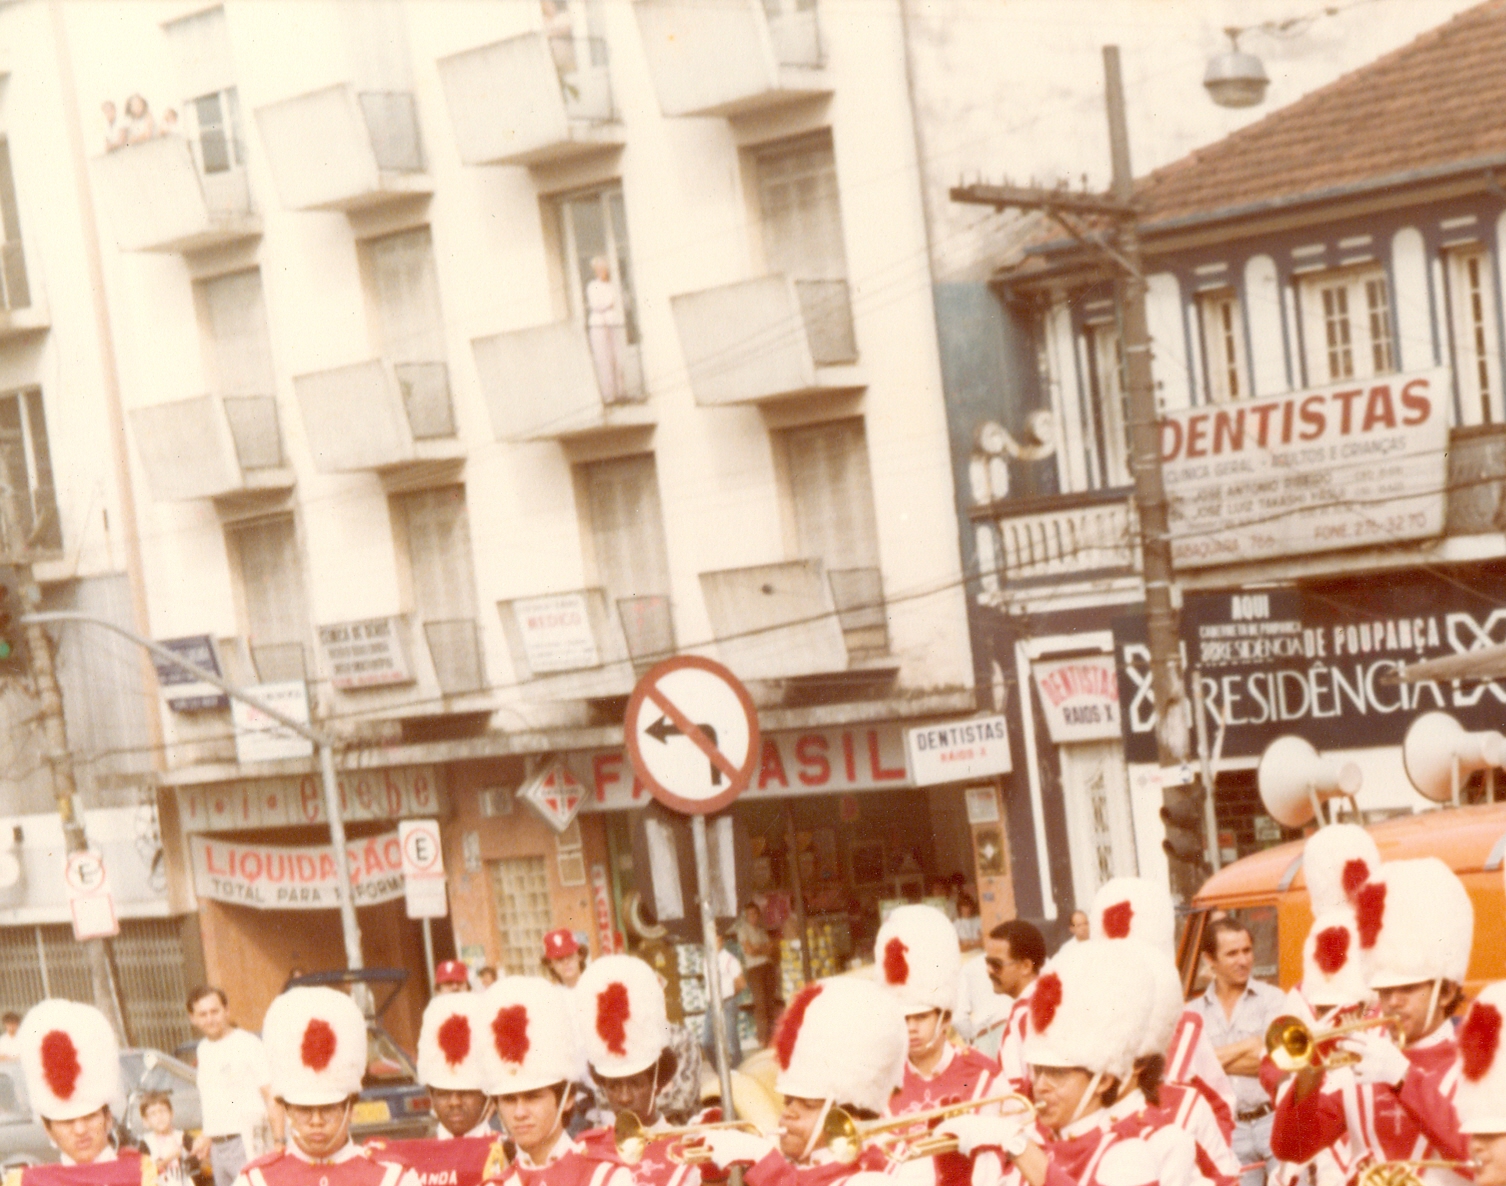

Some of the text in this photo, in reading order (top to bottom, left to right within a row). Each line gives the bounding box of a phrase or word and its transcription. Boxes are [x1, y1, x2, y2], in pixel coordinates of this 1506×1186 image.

[1158, 378, 1431, 463] DENTISTAS
[1333, 617, 1440, 656] POUPANÇA
[1199, 654, 1446, 726] RESIDÊNCIA
[916, 720, 1005, 751] DENTISTAS
[414, 838, 428, 861] E
[213, 879, 264, 904] TOTAL
[277, 886, 321, 903] PARA
[420, 1168, 458, 1186] ANDA
